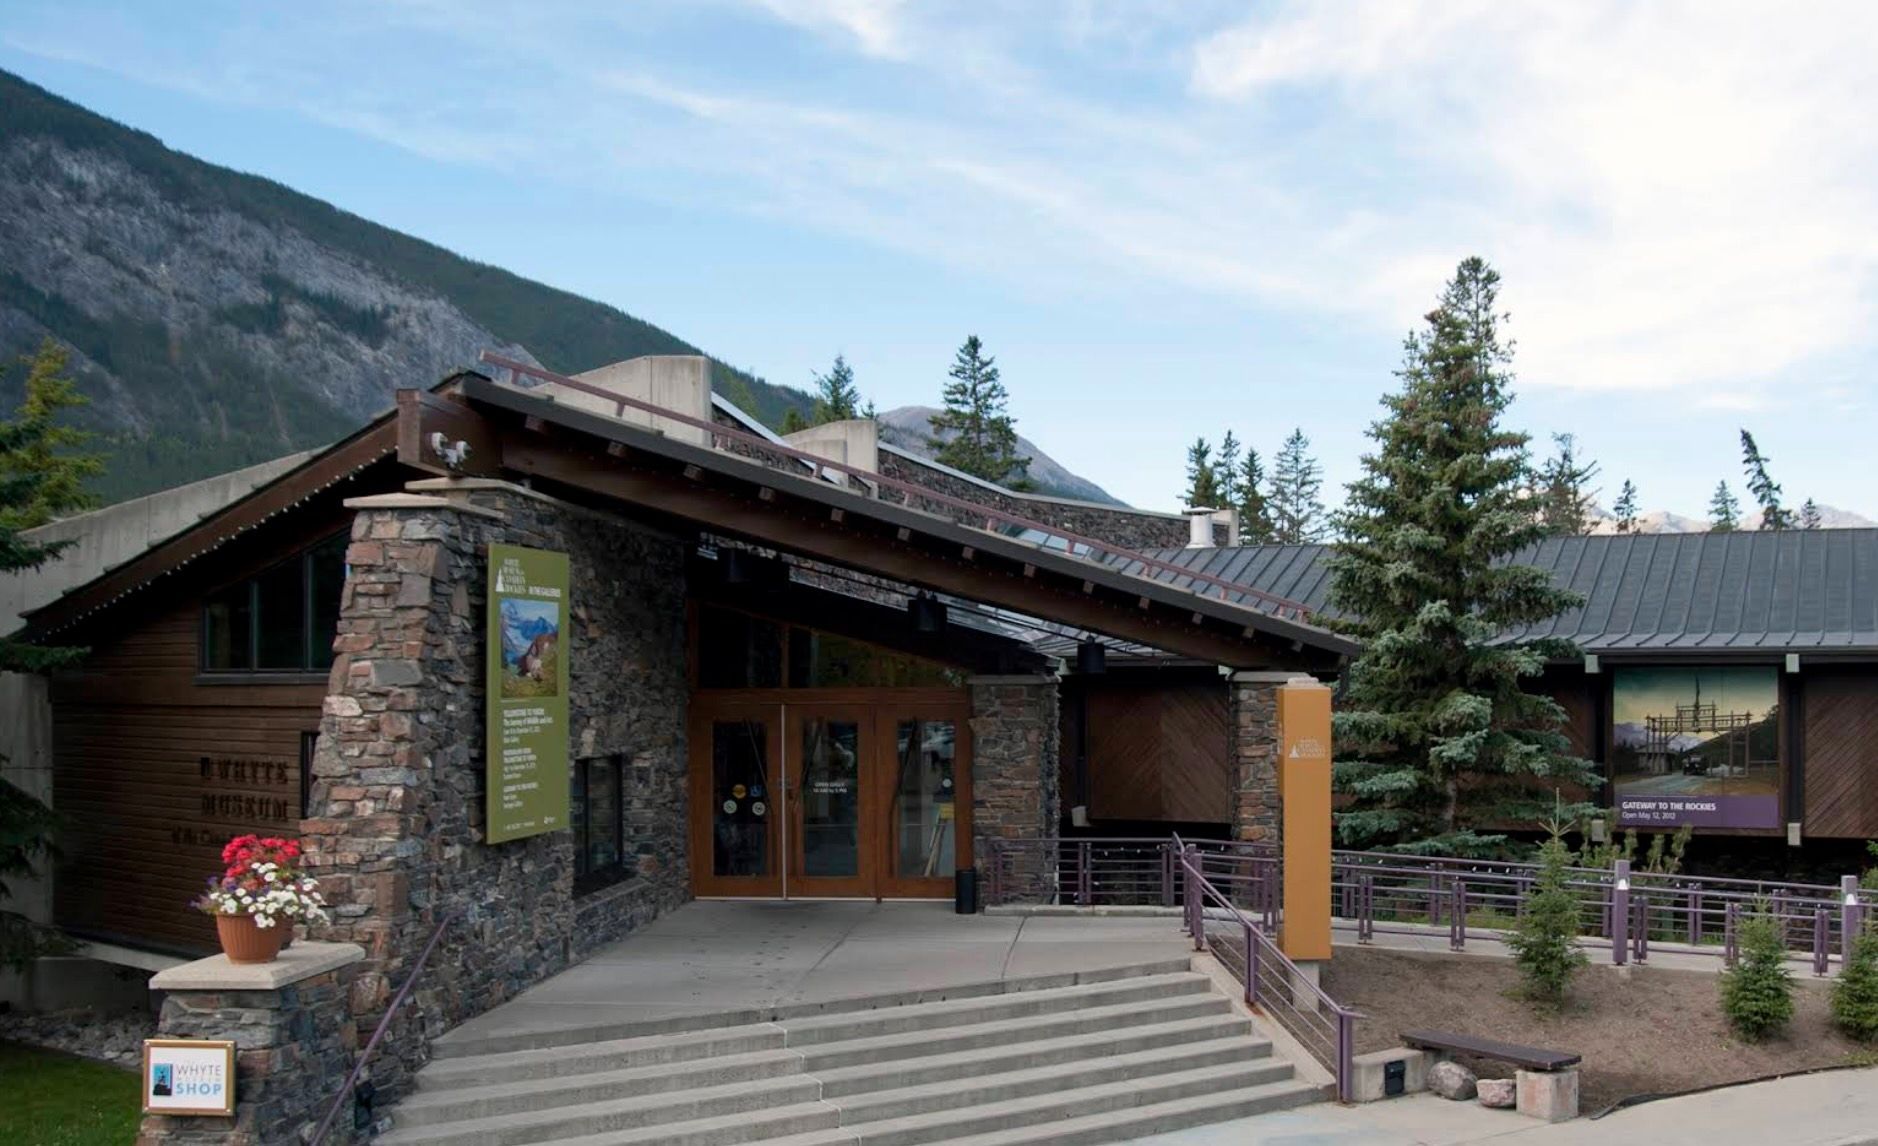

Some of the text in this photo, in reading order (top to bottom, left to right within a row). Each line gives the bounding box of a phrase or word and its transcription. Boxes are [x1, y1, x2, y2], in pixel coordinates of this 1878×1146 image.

[217, 759, 289, 785] WHYTE
[201, 794, 289, 822] MUSEUM
[1622, 801, 1716, 811] GATEWAY TO THE ROCKIES
[1622, 811, 1637, 820] Open
[1638, 811, 1651, 820] May
[176, 1064, 222, 1076] WHYTE
[176, 1082, 222, 1095] SHOP
